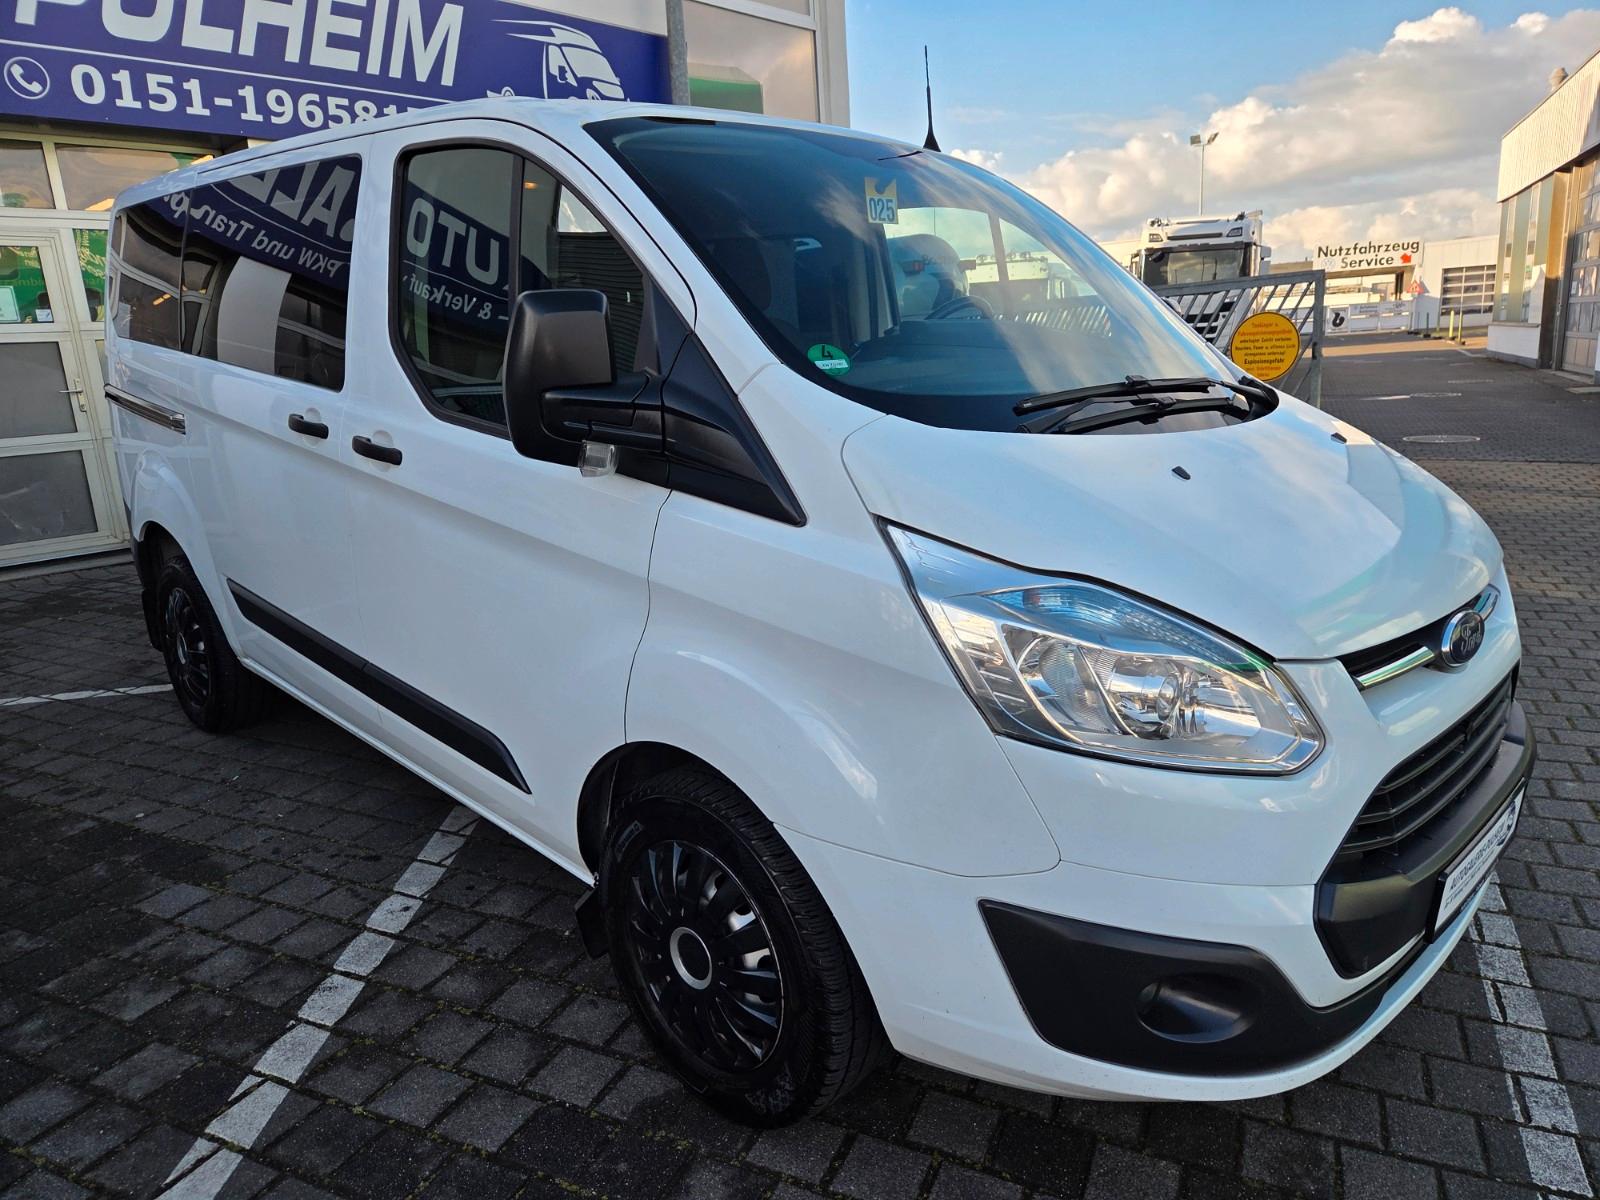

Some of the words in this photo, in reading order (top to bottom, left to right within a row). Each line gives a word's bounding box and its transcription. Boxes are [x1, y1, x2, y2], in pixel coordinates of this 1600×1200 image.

[70, 63, 417, 128] 0151-19658
[868, 197, 895, 222] 025
[1317, 241, 1419, 258] Nutzfahrzeug
[1341, 254, 1394, 269] Service
[821, 345, 833, 359] 4
